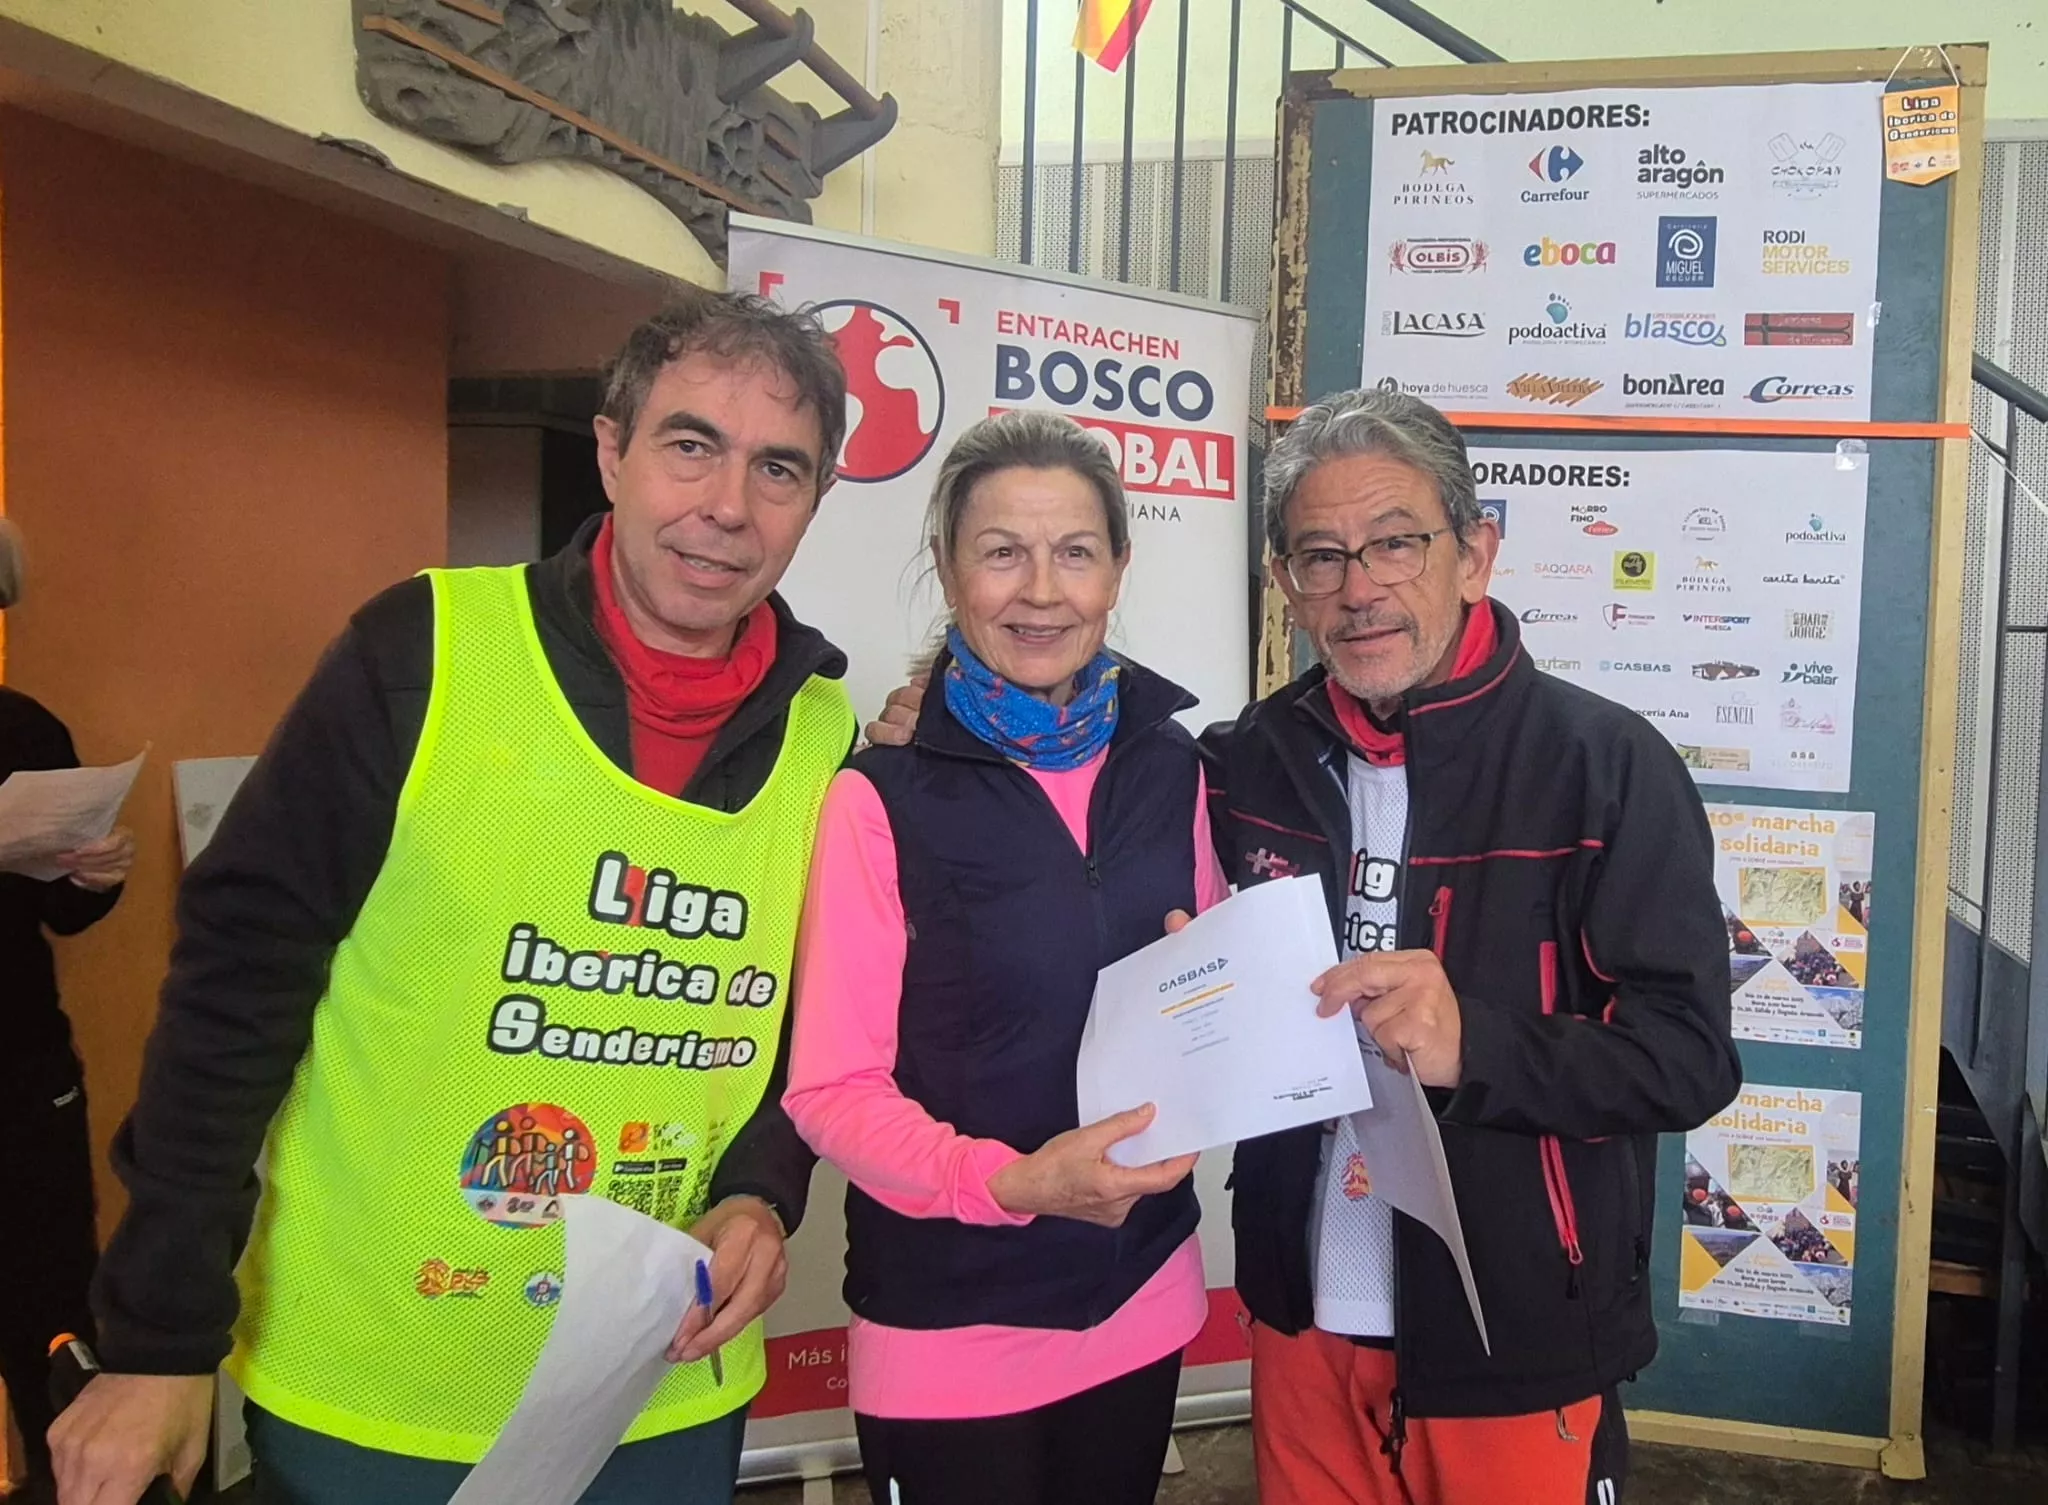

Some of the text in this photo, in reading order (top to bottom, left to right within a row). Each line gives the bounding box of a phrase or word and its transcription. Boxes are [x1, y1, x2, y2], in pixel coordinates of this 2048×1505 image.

[1391, 104, 1651, 136] PATROCINADORES:
[1638, 144, 1686, 165] alto
[1402, 183, 1466, 193] BODEGA
[1520, 188, 1590, 203] Carrefour
[1636, 191, 1720, 200] SUPERMERCADOS
[1393, 194, 1475, 205] PIRINEOS
[1763, 230, 1806, 244] RODI
[1523, 237, 1617, 267] eboca
[1762, 245, 1829, 259] MOTOR
[1665, 260, 1705, 275] MIGUEL
[1761, 260, 1851, 275] SERVICES
[1393, 311, 1486, 336] LACASA
[1624, 313, 1718, 341] blasco
[998, 310, 1180, 360] ENTARACHEN
[1508, 323, 1606, 345] podoactiva
[995, 344, 1214, 422] BOSCO
[1402, 382, 1488, 394] hoya de huesca
[1750, 376, 1854, 404] Correas
[1471, 462, 1630, 487] ORADORES:
[1785, 530, 1846, 544] podoactiva
[1534, 562, 1593, 574] SAQQARA
[1676, 584, 1732, 593] PIRINEOS
[1682, 576, 1726, 584] BODEGA
[1520, 608, 1579, 624] Correas
[1693, 614, 1751, 625] INTERSPORT
[1614, 662, 1671, 673] CASBAS
[1804, 661, 1833, 674] vive
[1803, 671, 1839, 685] balar
[1669, 709, 1690, 719] Ana
[1716, 706, 1754, 725] ESENCIA
[1752, 813, 1836, 834] marcha
[1720, 834, 1820, 857] solidaria
[589, 850, 748, 939] Liga
[726, 966, 776, 1007] de
[1158, 963, 1218, 993] CASBAS
[488, 994, 756, 1070] Senderismo
[1740, 1090, 1824, 1112] marcha
[789, 1345, 833, 1370] Más
